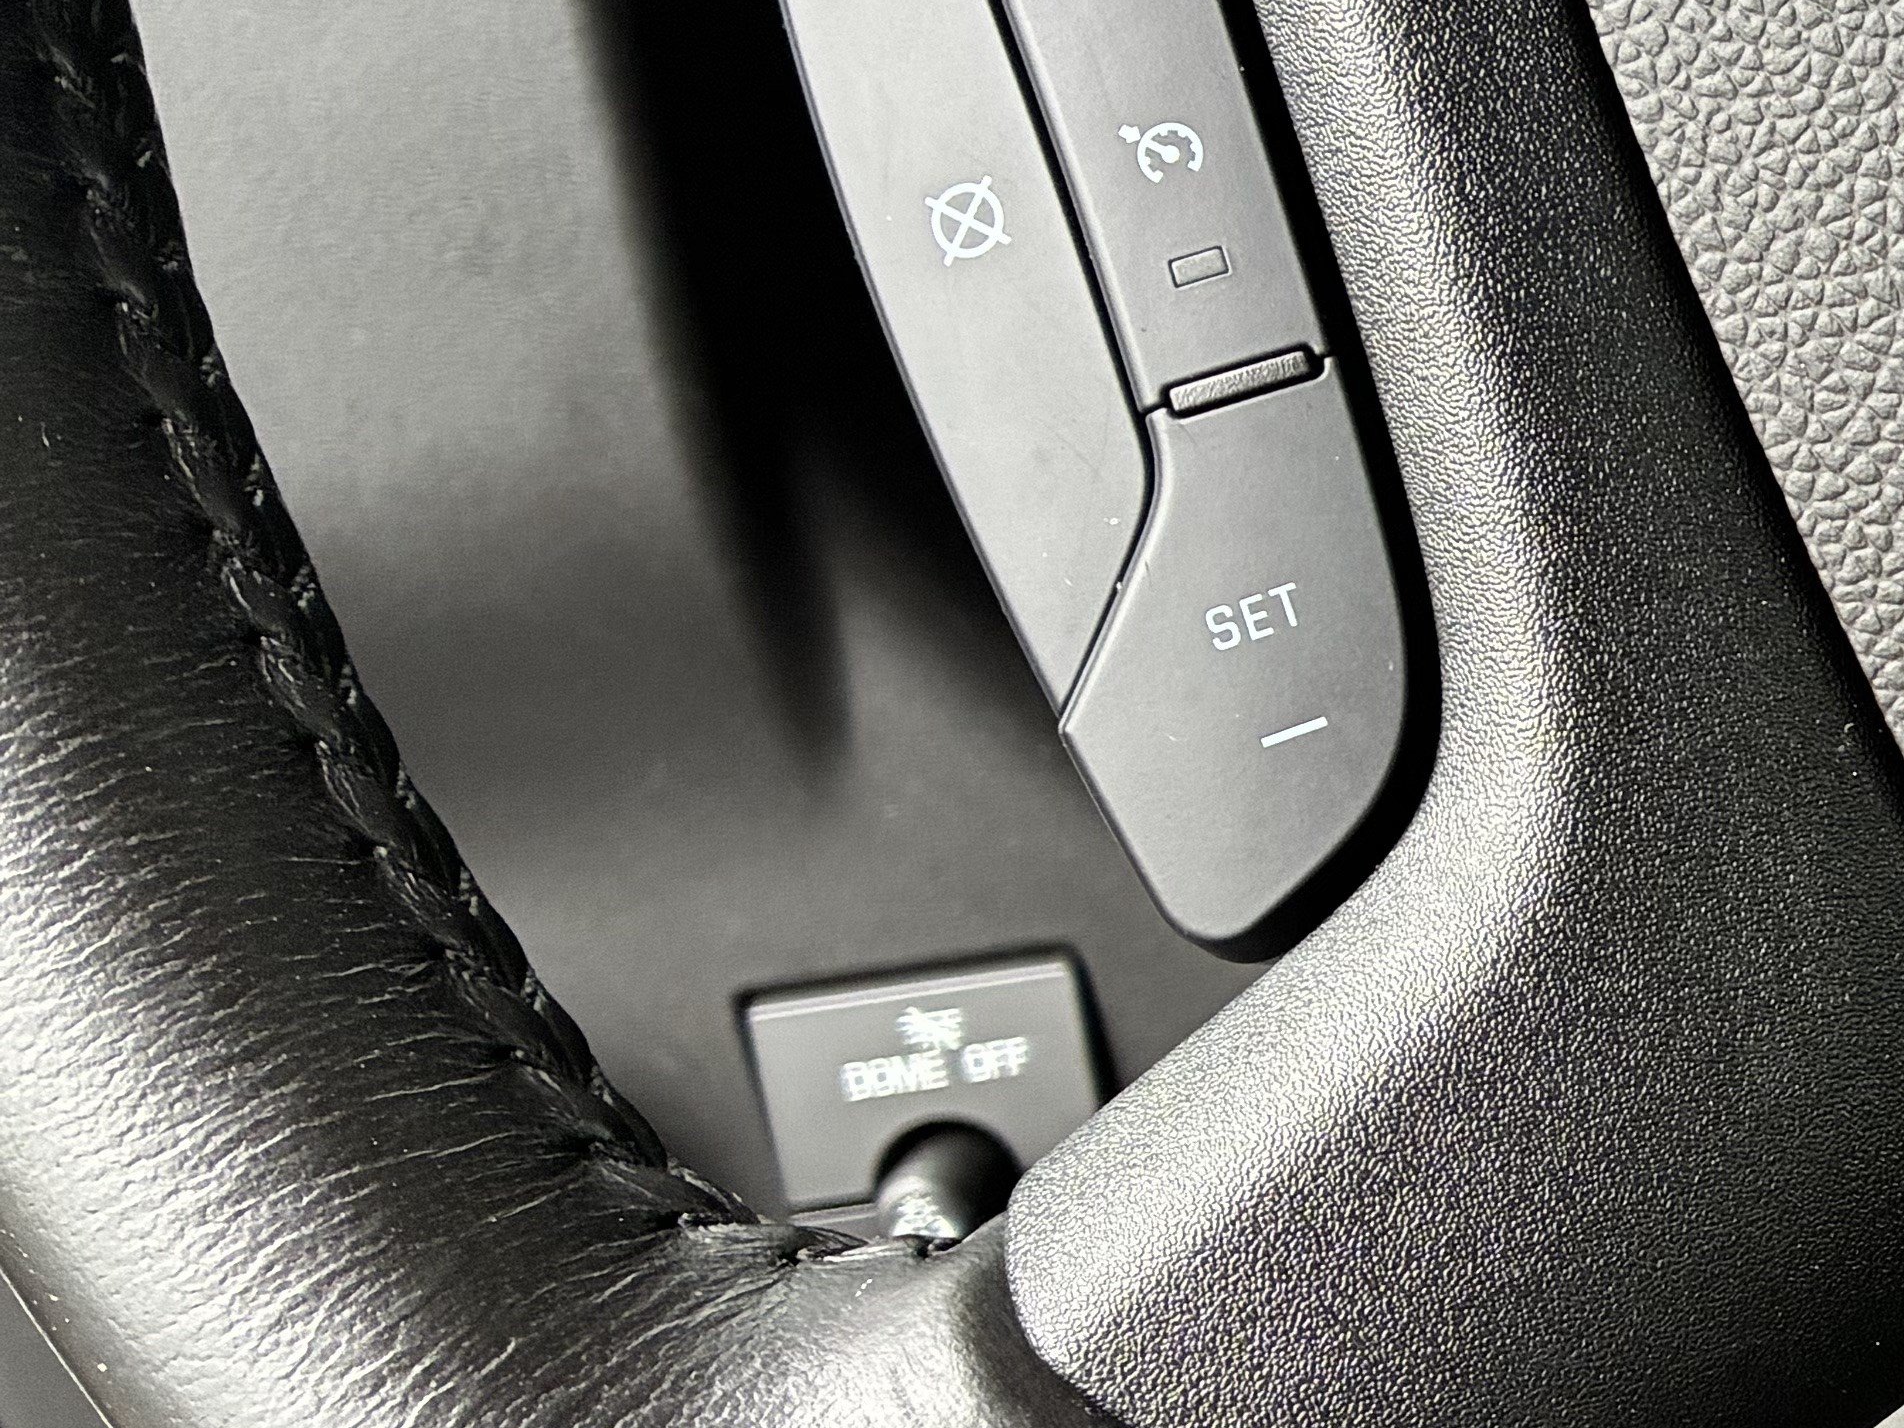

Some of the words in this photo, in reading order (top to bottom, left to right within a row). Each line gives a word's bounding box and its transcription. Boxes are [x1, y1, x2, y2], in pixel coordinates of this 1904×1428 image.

[1204, 581, 1299, 652] SET
[841, 1049, 949, 1102] DOME
[961, 1036, 1028, 1084] OFF
